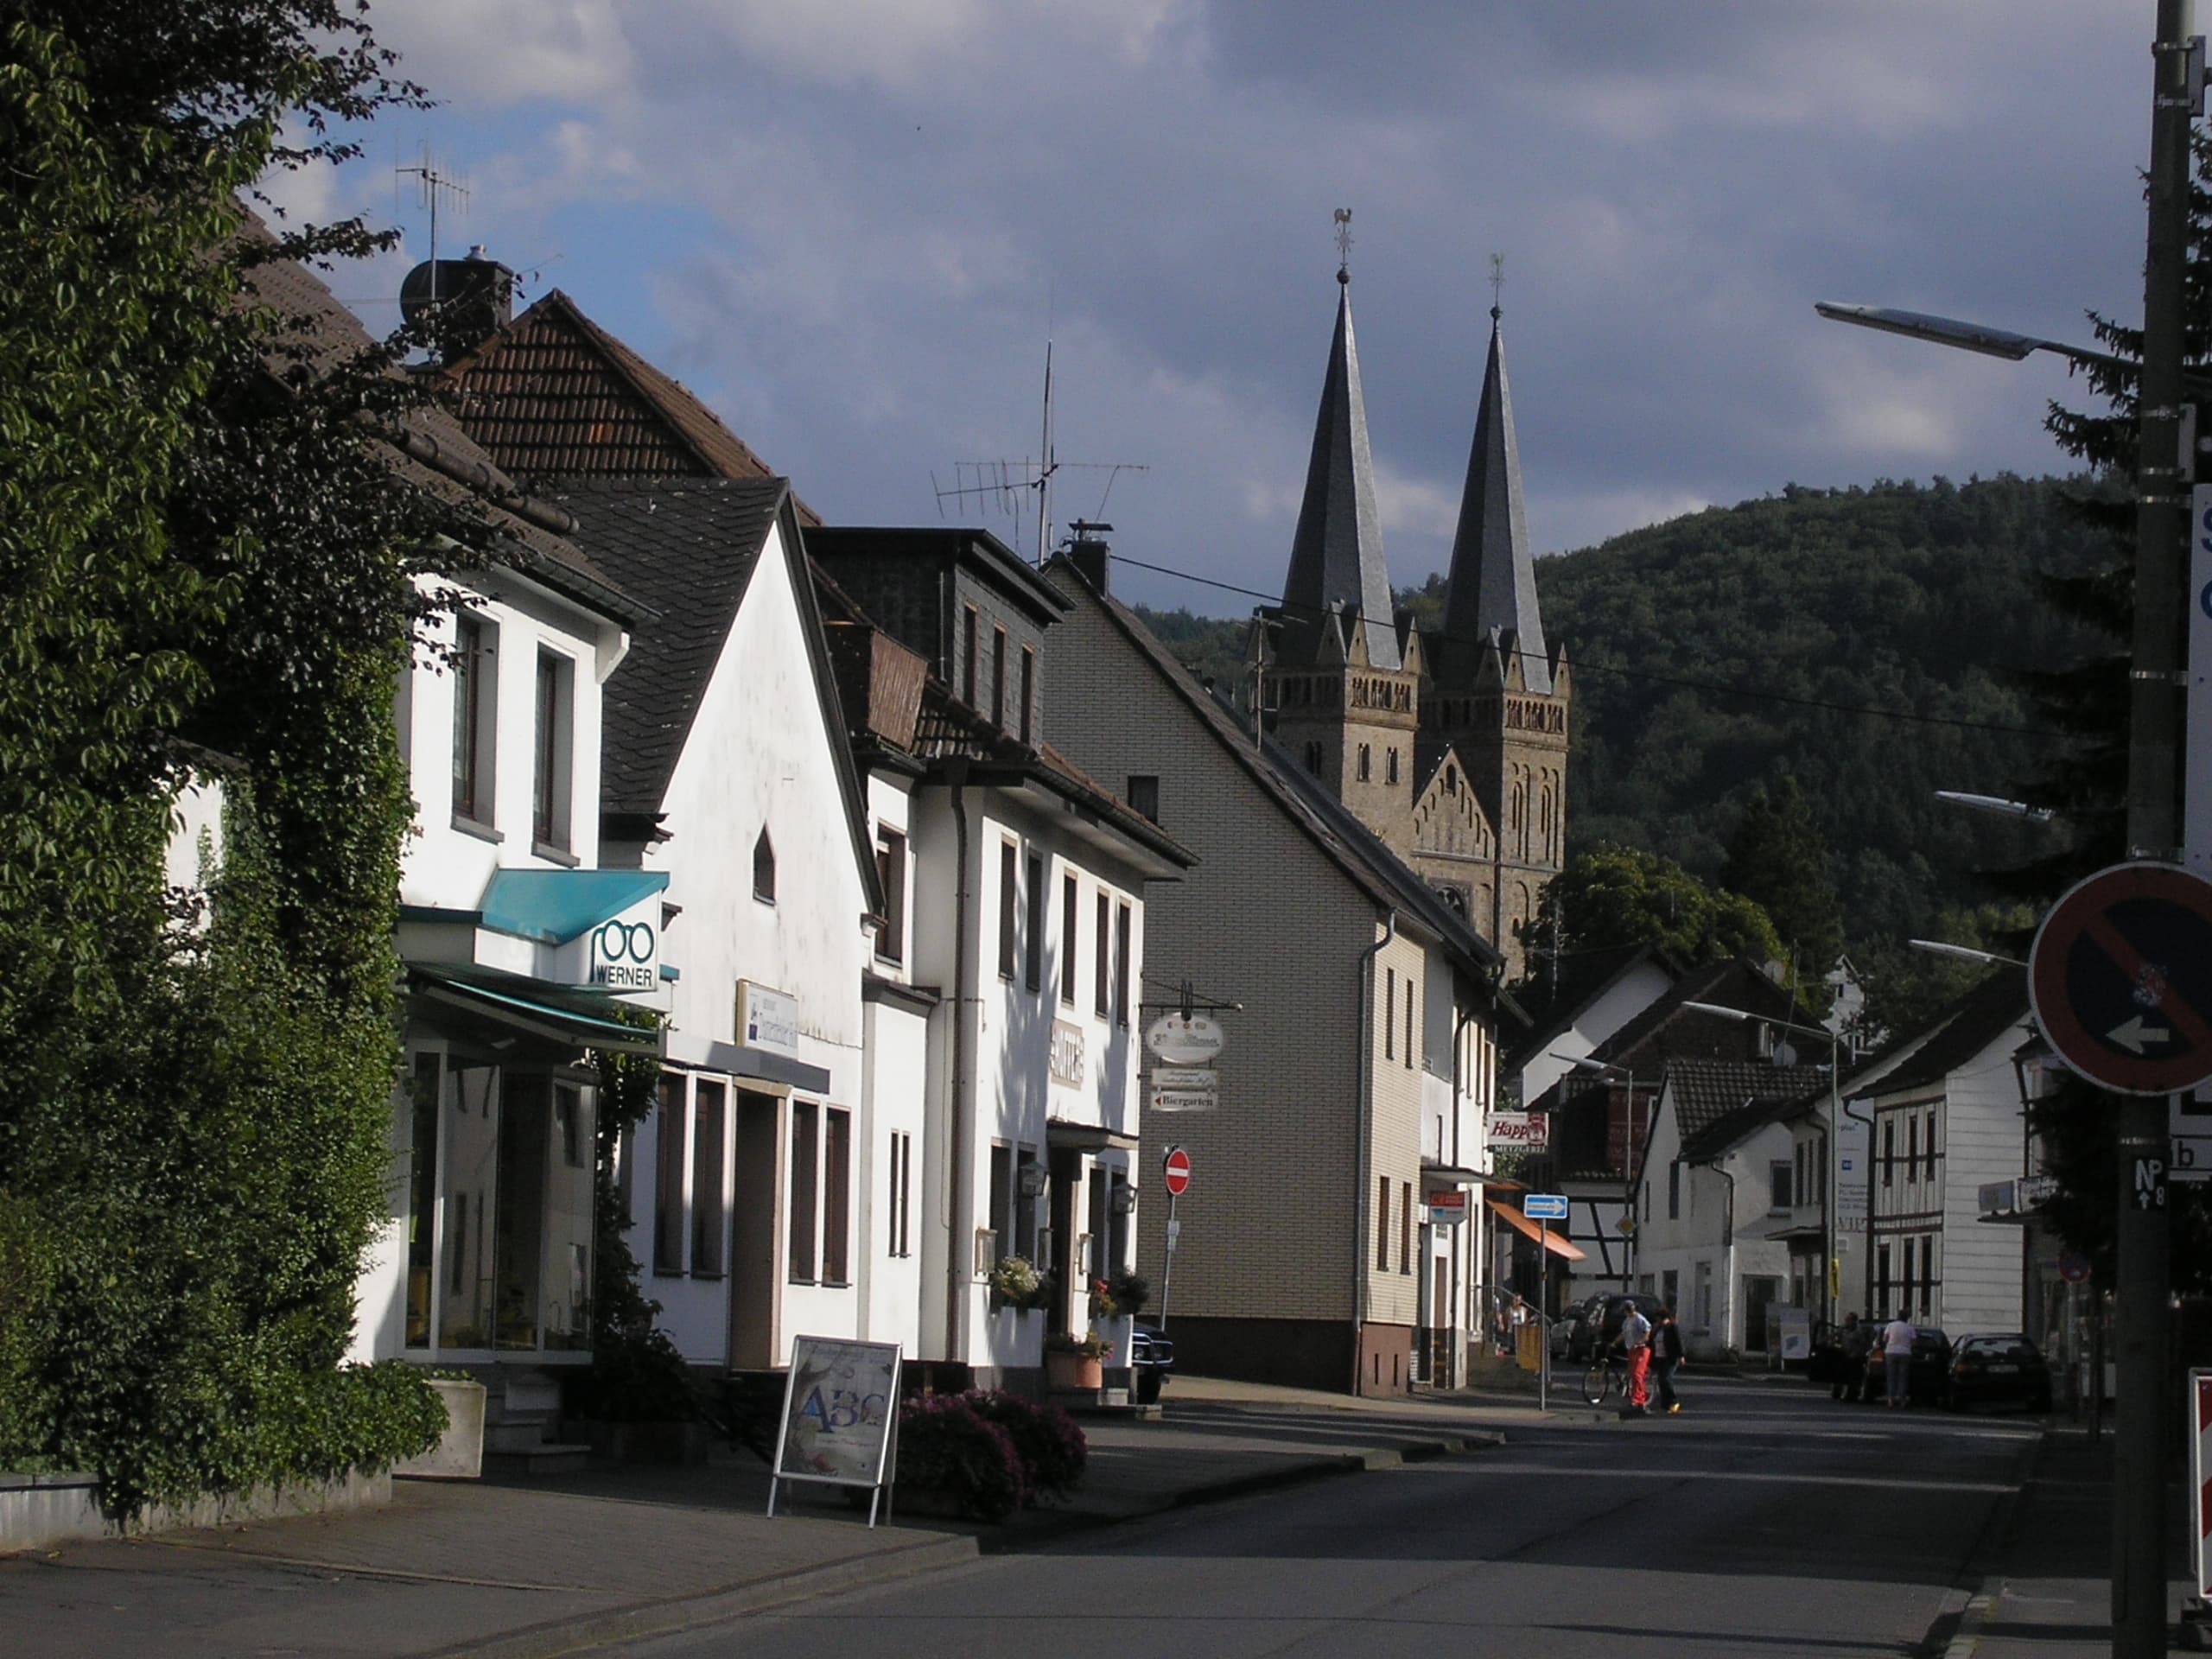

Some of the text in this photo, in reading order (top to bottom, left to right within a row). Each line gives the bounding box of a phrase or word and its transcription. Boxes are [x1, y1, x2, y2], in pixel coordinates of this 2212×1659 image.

[596, 965, 652, 987] WERNER
[1163, 1095, 1213, 1107] Biergarten
[1491, 1121, 1529, 1139] Happ
[800, 1385, 885, 1433] ABC
